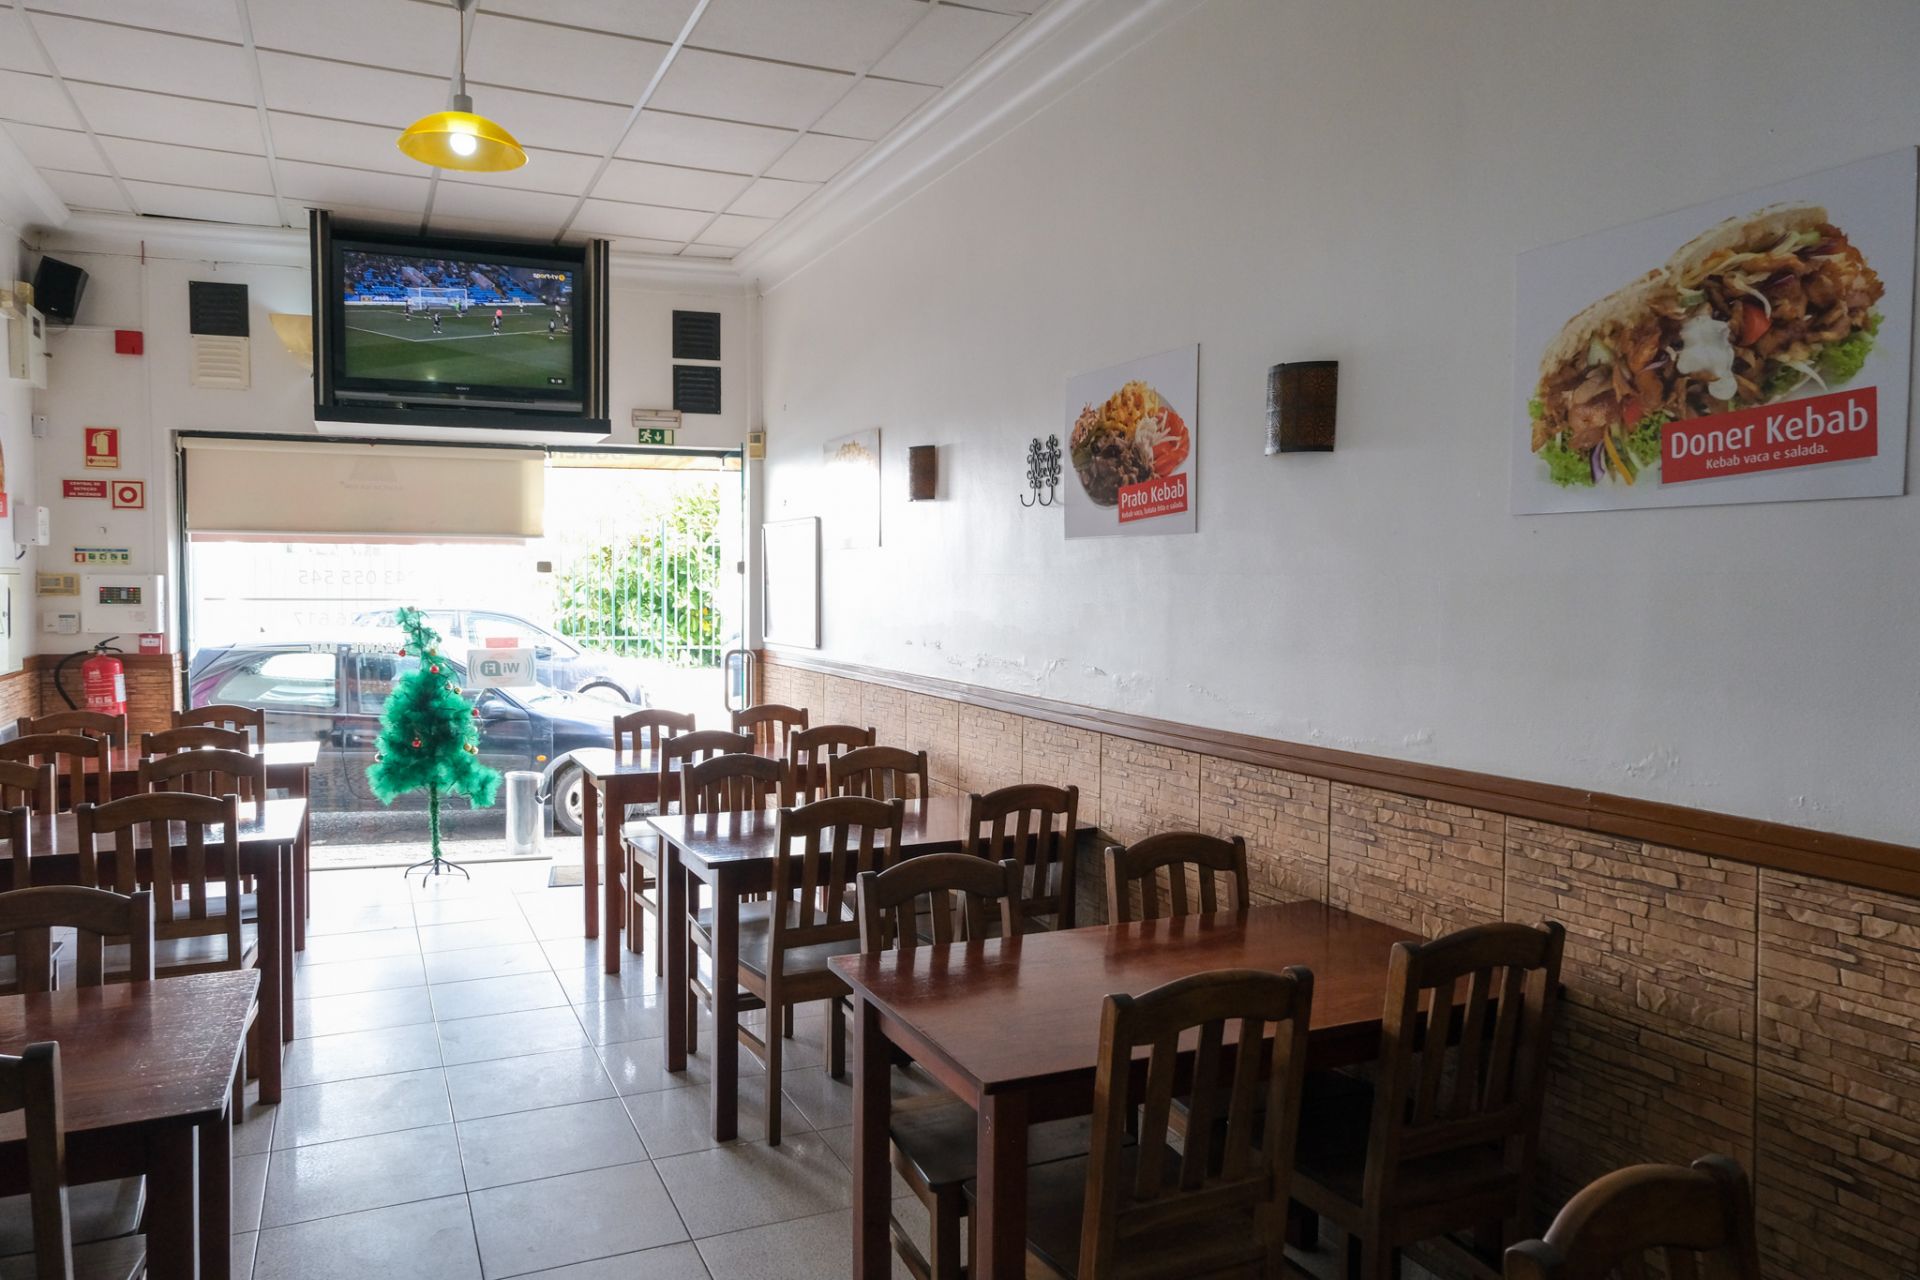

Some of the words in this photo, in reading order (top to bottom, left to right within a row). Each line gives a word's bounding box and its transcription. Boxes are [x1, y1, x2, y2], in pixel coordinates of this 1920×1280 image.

[1671, 424, 1755, 459] Doner
[1766, 399, 1869, 444] Kebab
[1706, 454, 1740, 470] Kebab
[1744, 451, 1770, 464] vaca
[1773, 451, 1782, 460] e
[1784, 443, 1828, 459] salada.
[1121, 490, 1148, 508] Prato
[1151, 479, 1185, 502] Kebab
